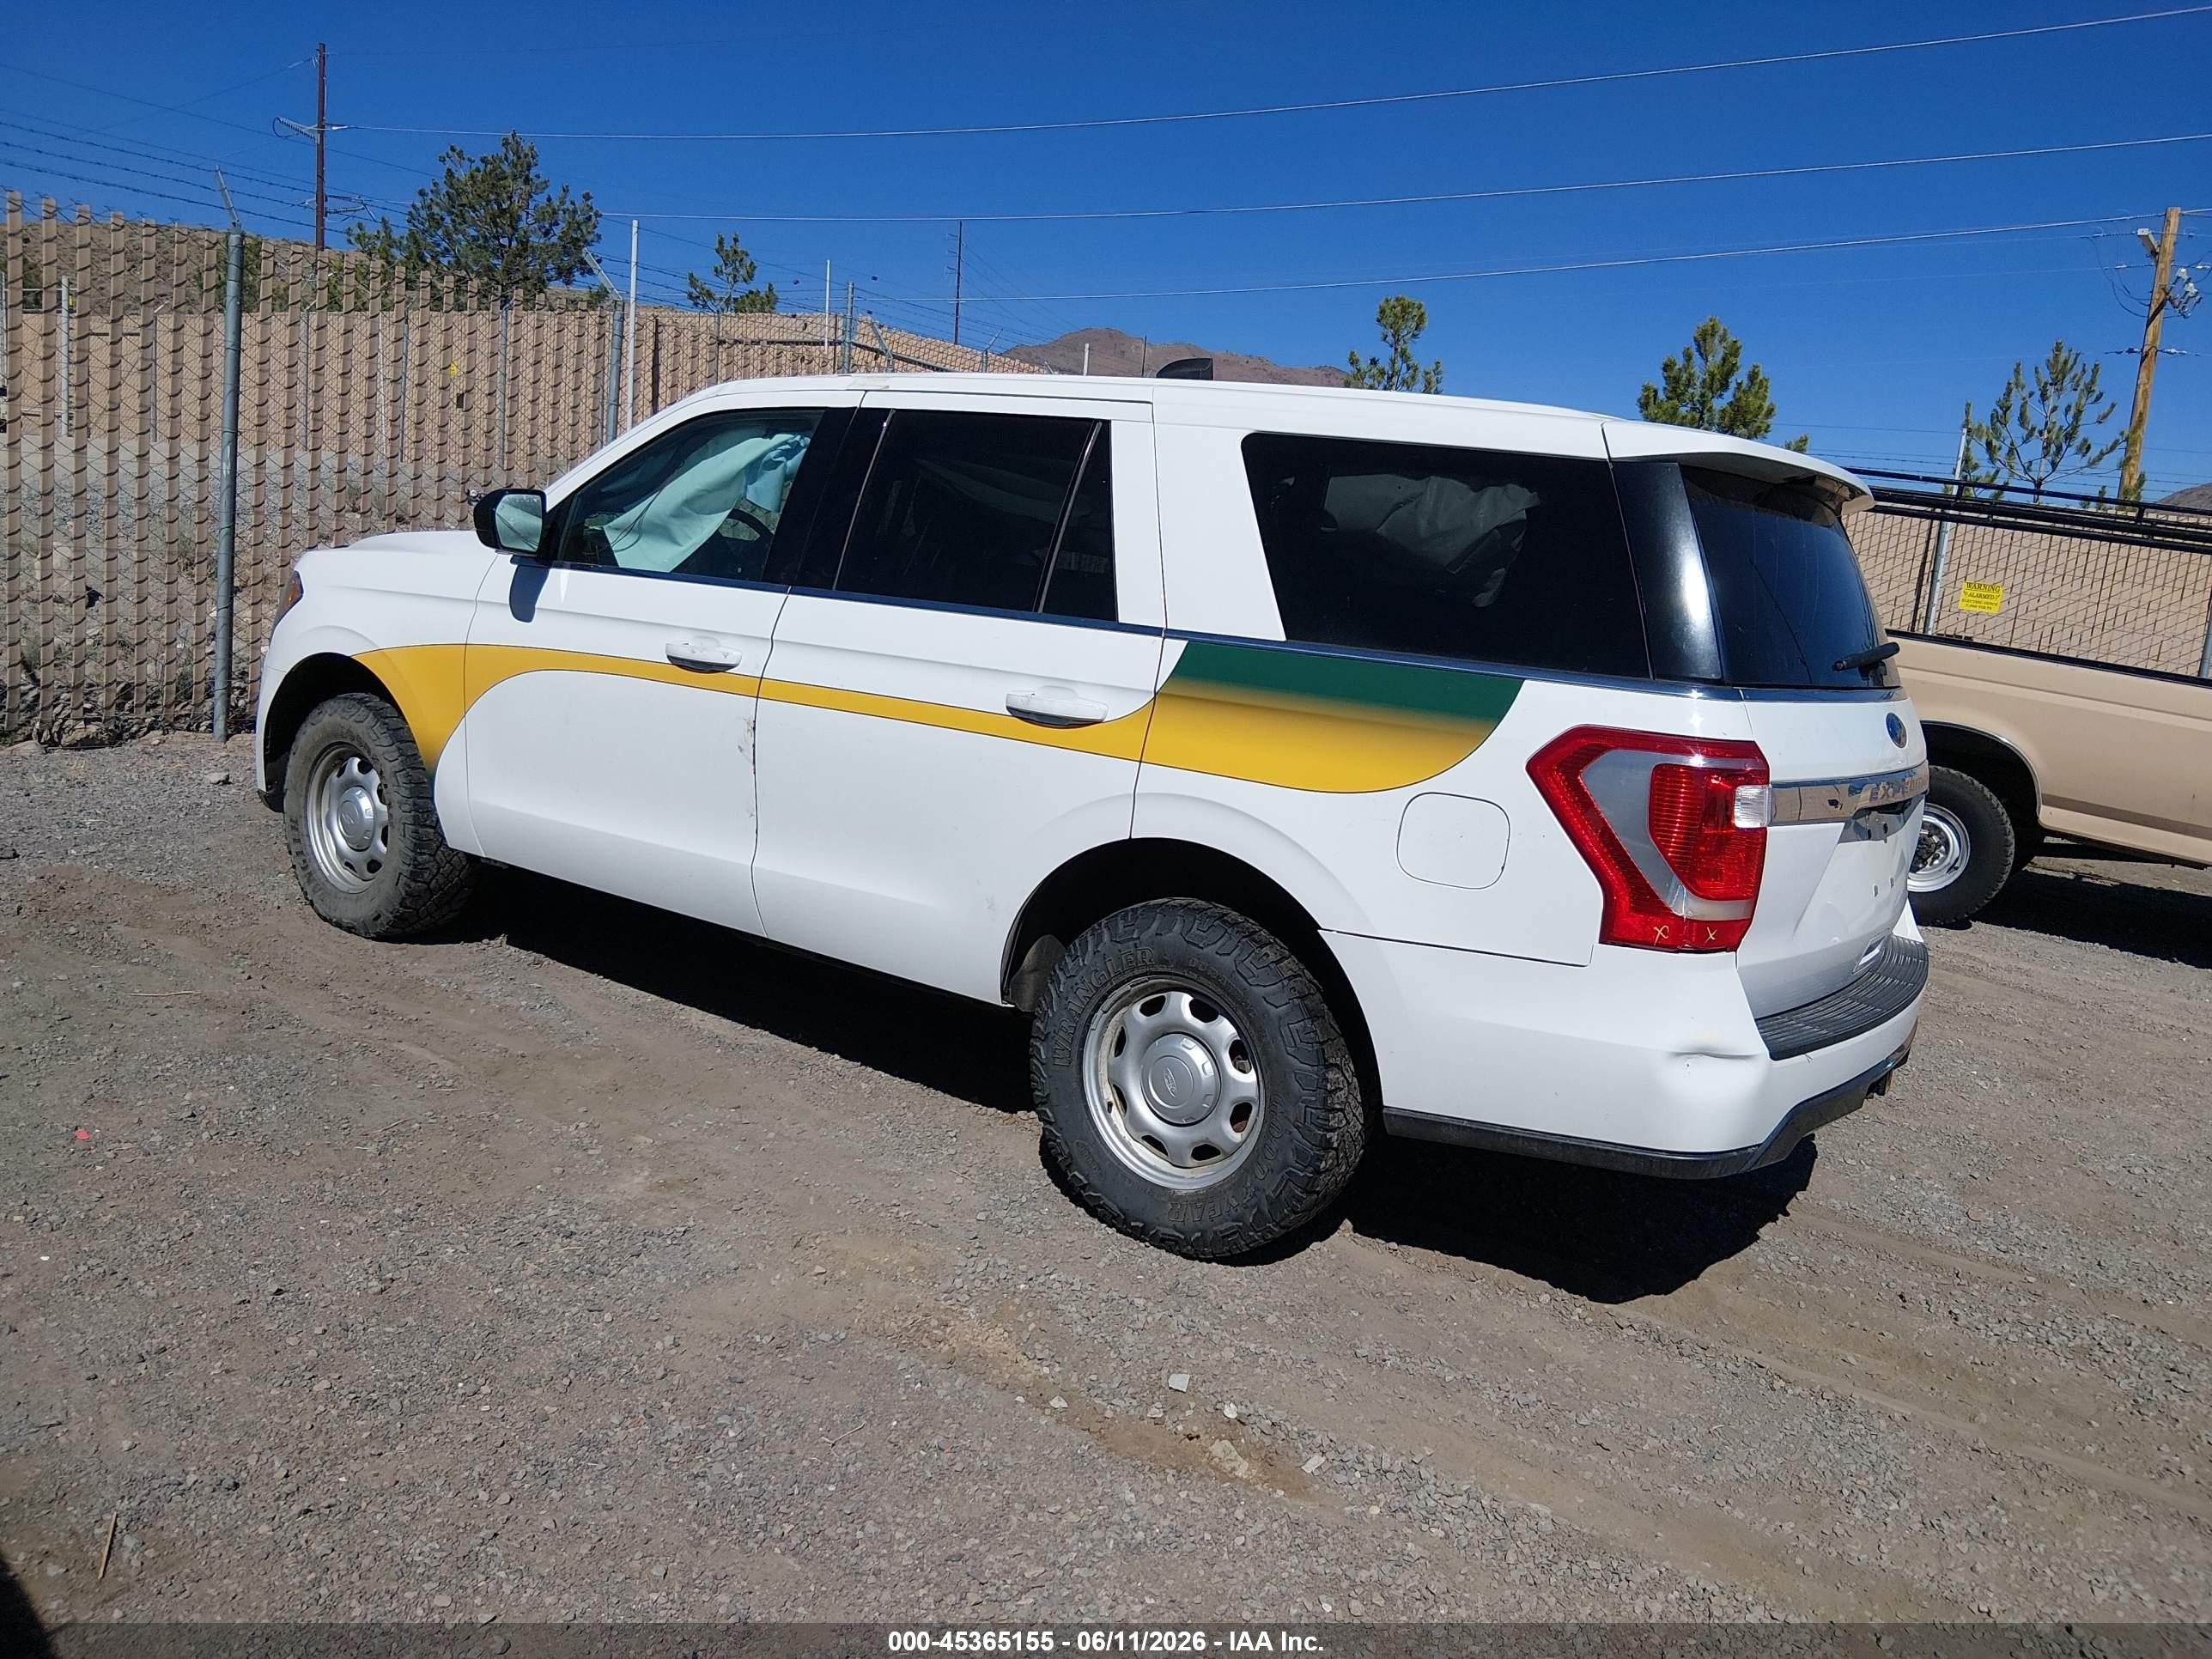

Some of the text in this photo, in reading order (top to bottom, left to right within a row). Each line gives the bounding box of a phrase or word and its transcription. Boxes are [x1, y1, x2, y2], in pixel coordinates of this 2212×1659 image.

[1966, 581, 2001, 592] WARNING
[1968, 592, 1995, 600] ALARMED
[1052, 946, 1154, 1066] WRANGLER
